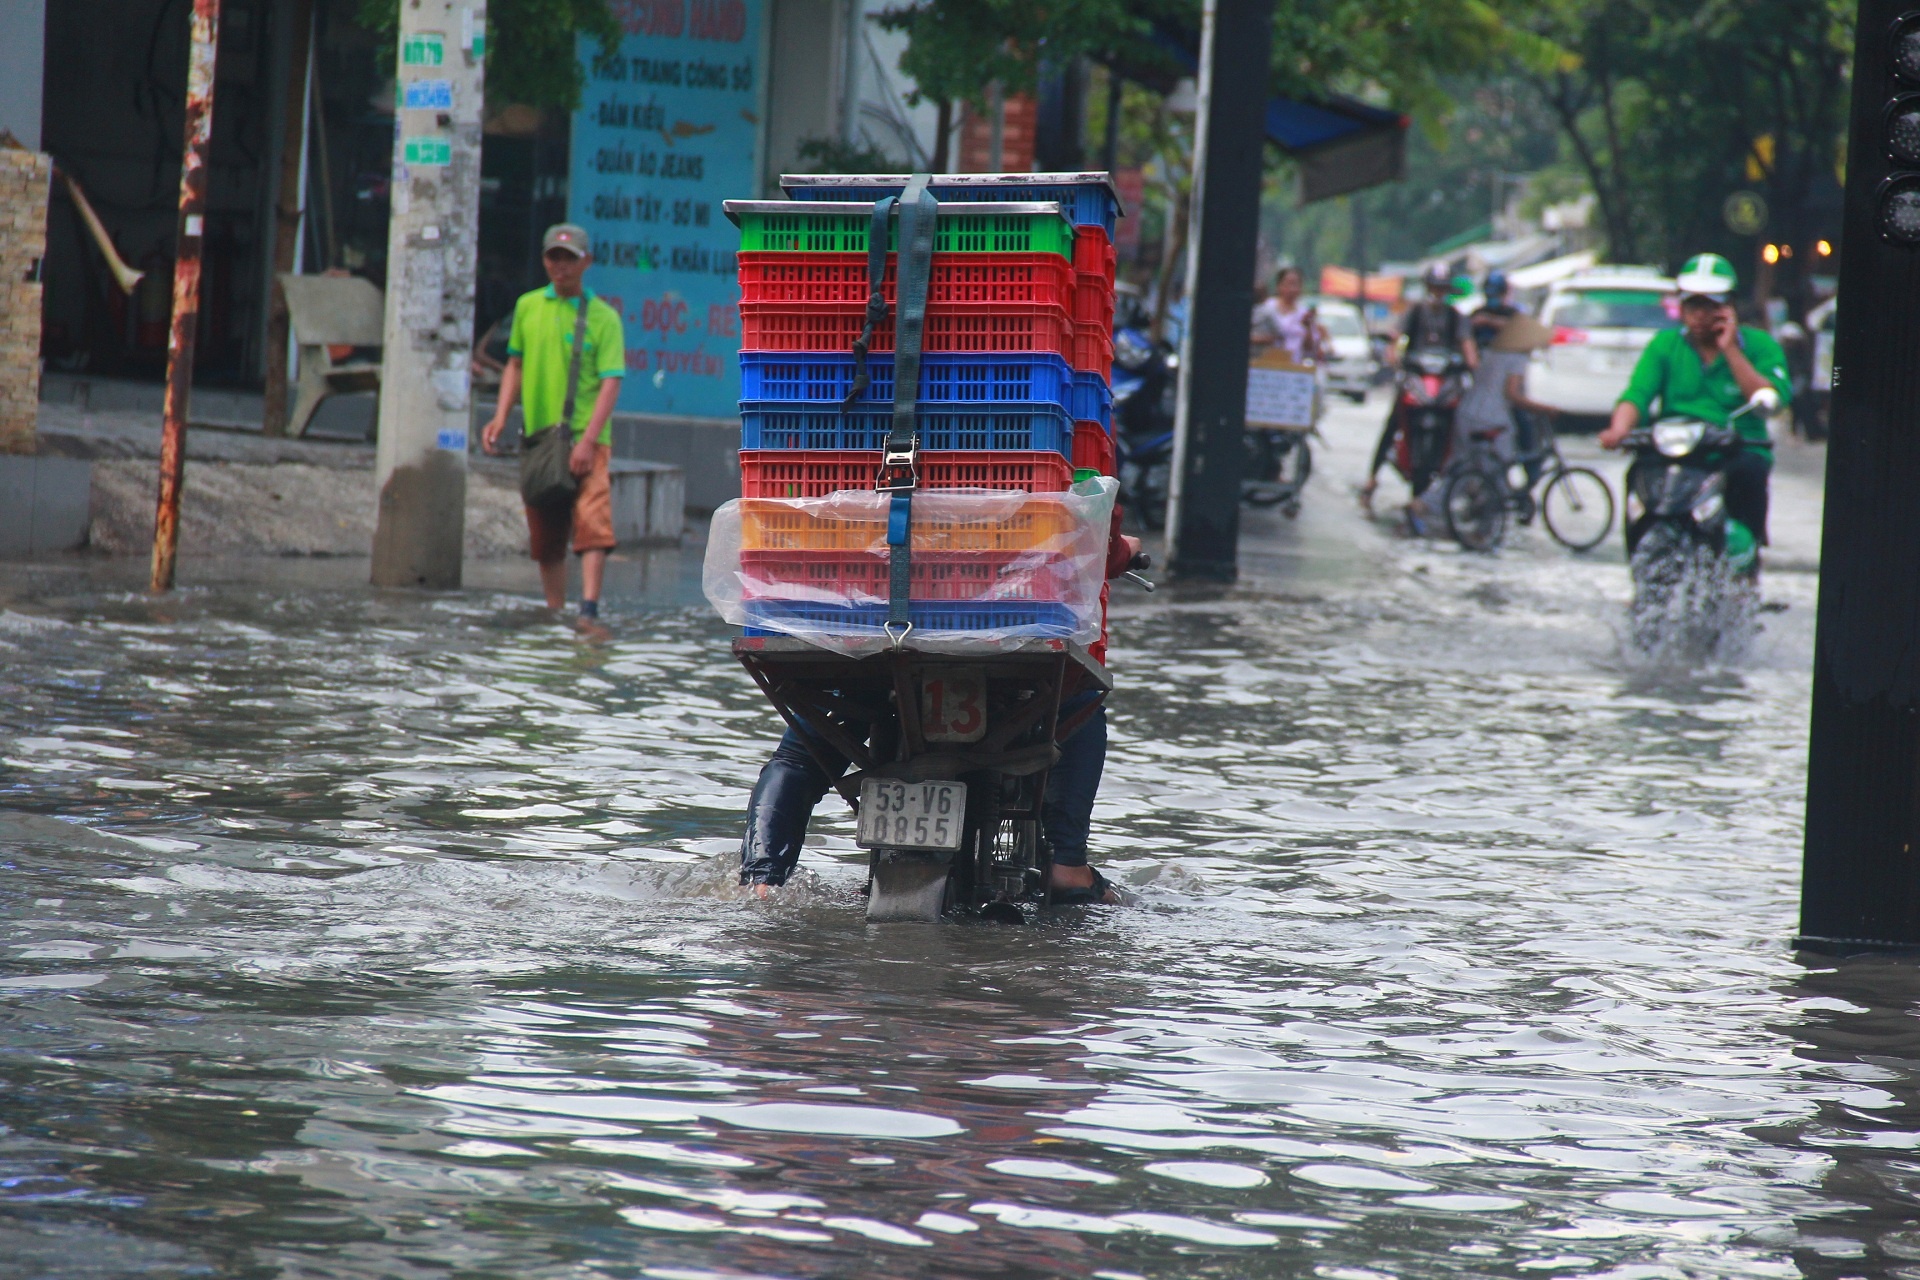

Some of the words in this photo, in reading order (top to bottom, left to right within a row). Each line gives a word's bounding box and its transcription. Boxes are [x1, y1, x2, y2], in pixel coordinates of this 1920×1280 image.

[604, 0, 684, 38] ECOND
[660, 153, 704, 181] JEANS
[924, 678, 982, 735] 13
[873, 814, 950, 846] 0855
